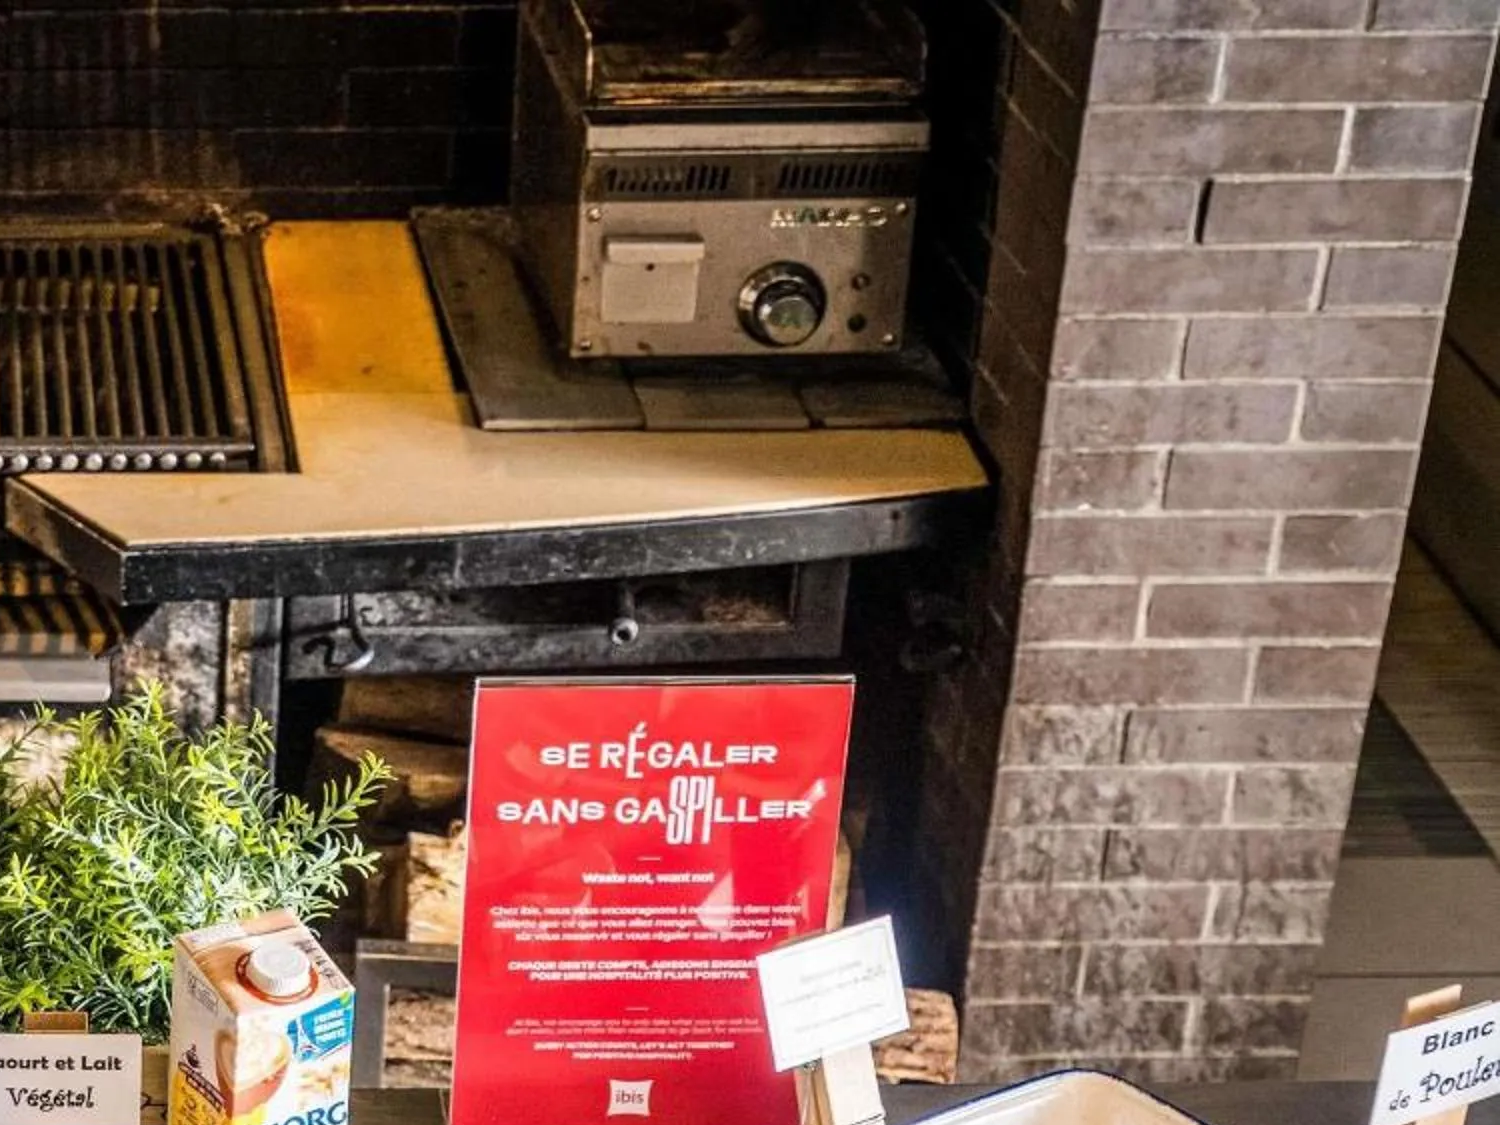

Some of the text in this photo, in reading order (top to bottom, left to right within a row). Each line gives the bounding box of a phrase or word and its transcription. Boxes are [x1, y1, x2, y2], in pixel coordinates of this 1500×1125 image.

[540, 722, 778, 779] SE RÉGALER
[496, 776, 812, 844] SANS GASPILLER
[583, 872, 625, 884] Waste
[655, 871, 689, 883] want
[690, 871, 714, 883] not
[1422, 1021, 1495, 1054] Blanc
[55, 1056, 75, 1071] et
[81, 1056, 122, 1071] Lait
[6, 1086, 95, 1112] Végétal
[615, 1090, 644, 1105] ibis
[1389, 1090, 1411, 1111] de
